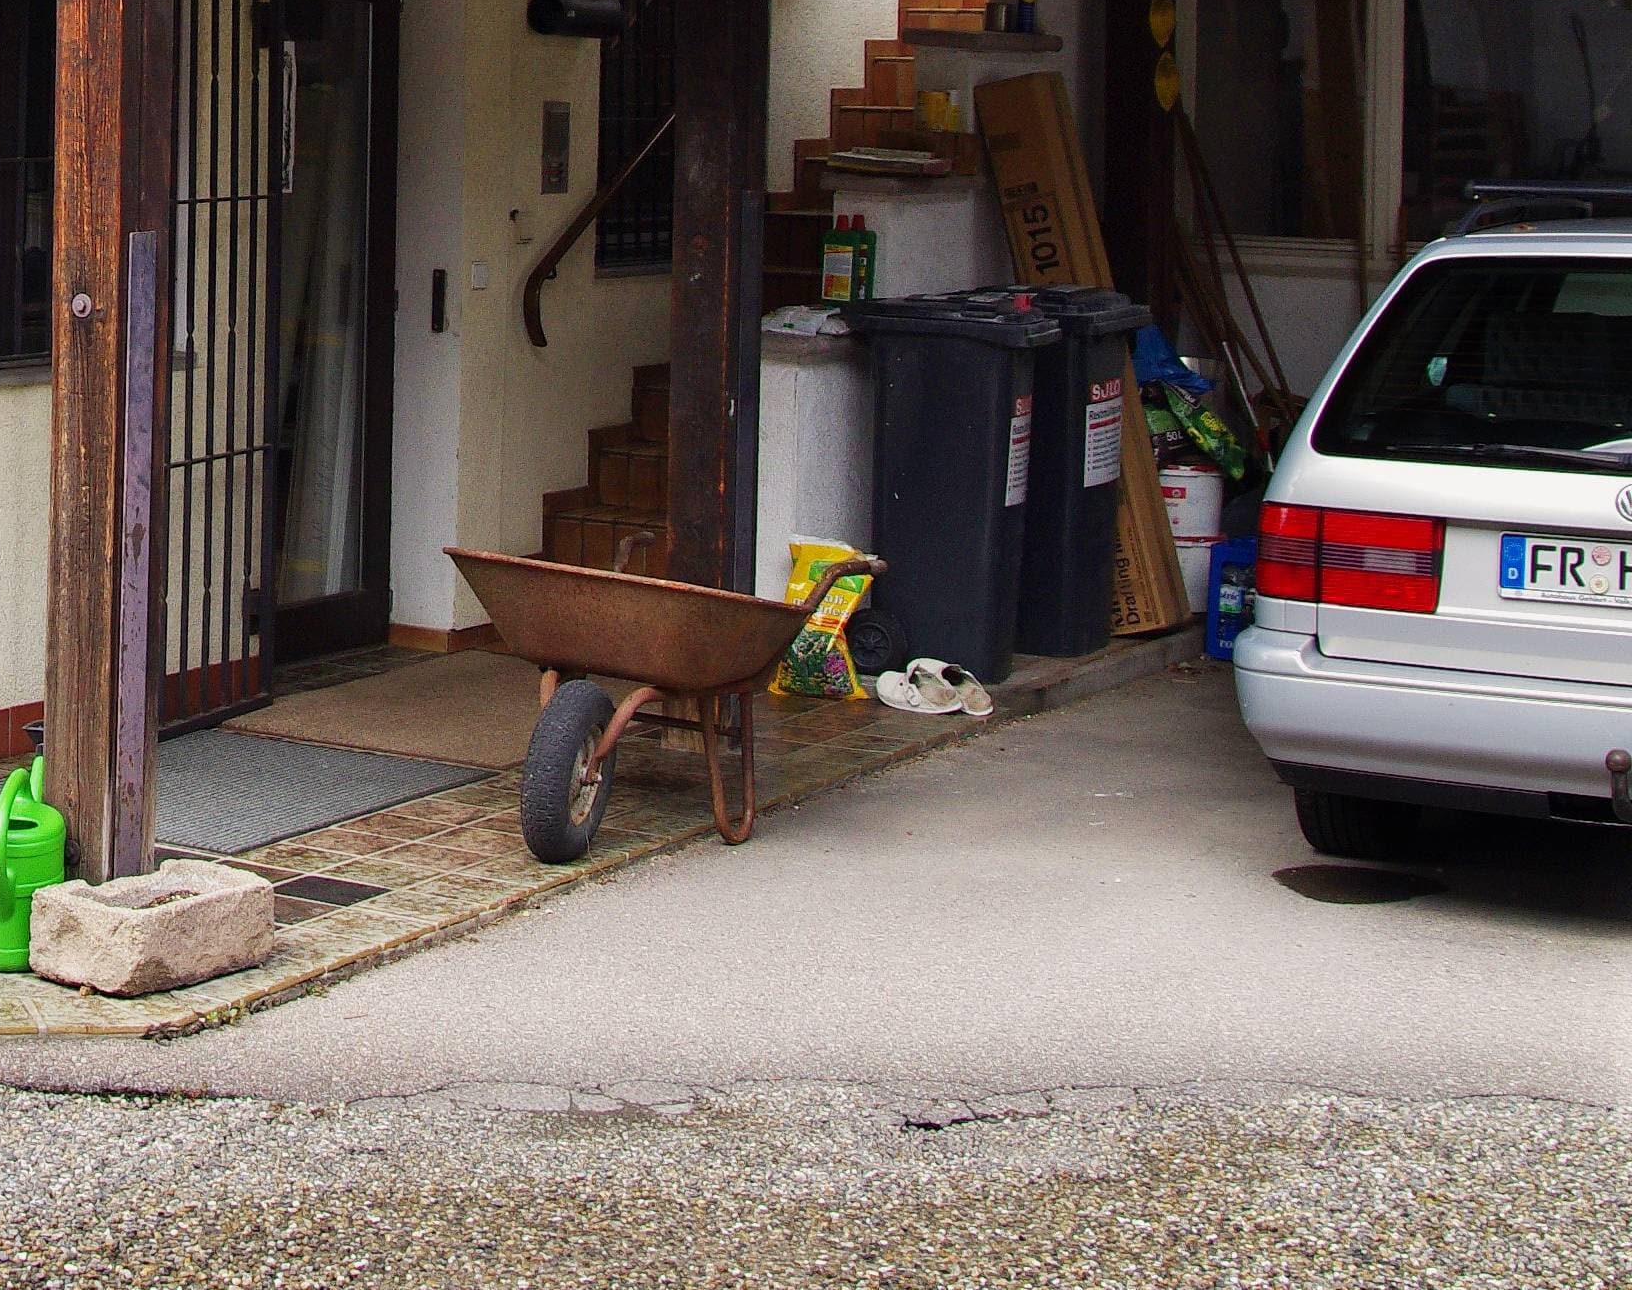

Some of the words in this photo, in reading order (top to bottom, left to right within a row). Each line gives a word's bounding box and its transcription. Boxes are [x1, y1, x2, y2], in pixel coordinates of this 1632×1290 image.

[1023, 204, 1060, 275] 1015
[1507, 567, 1519, 580] D
[1529, 544, 1586, 588] FR
